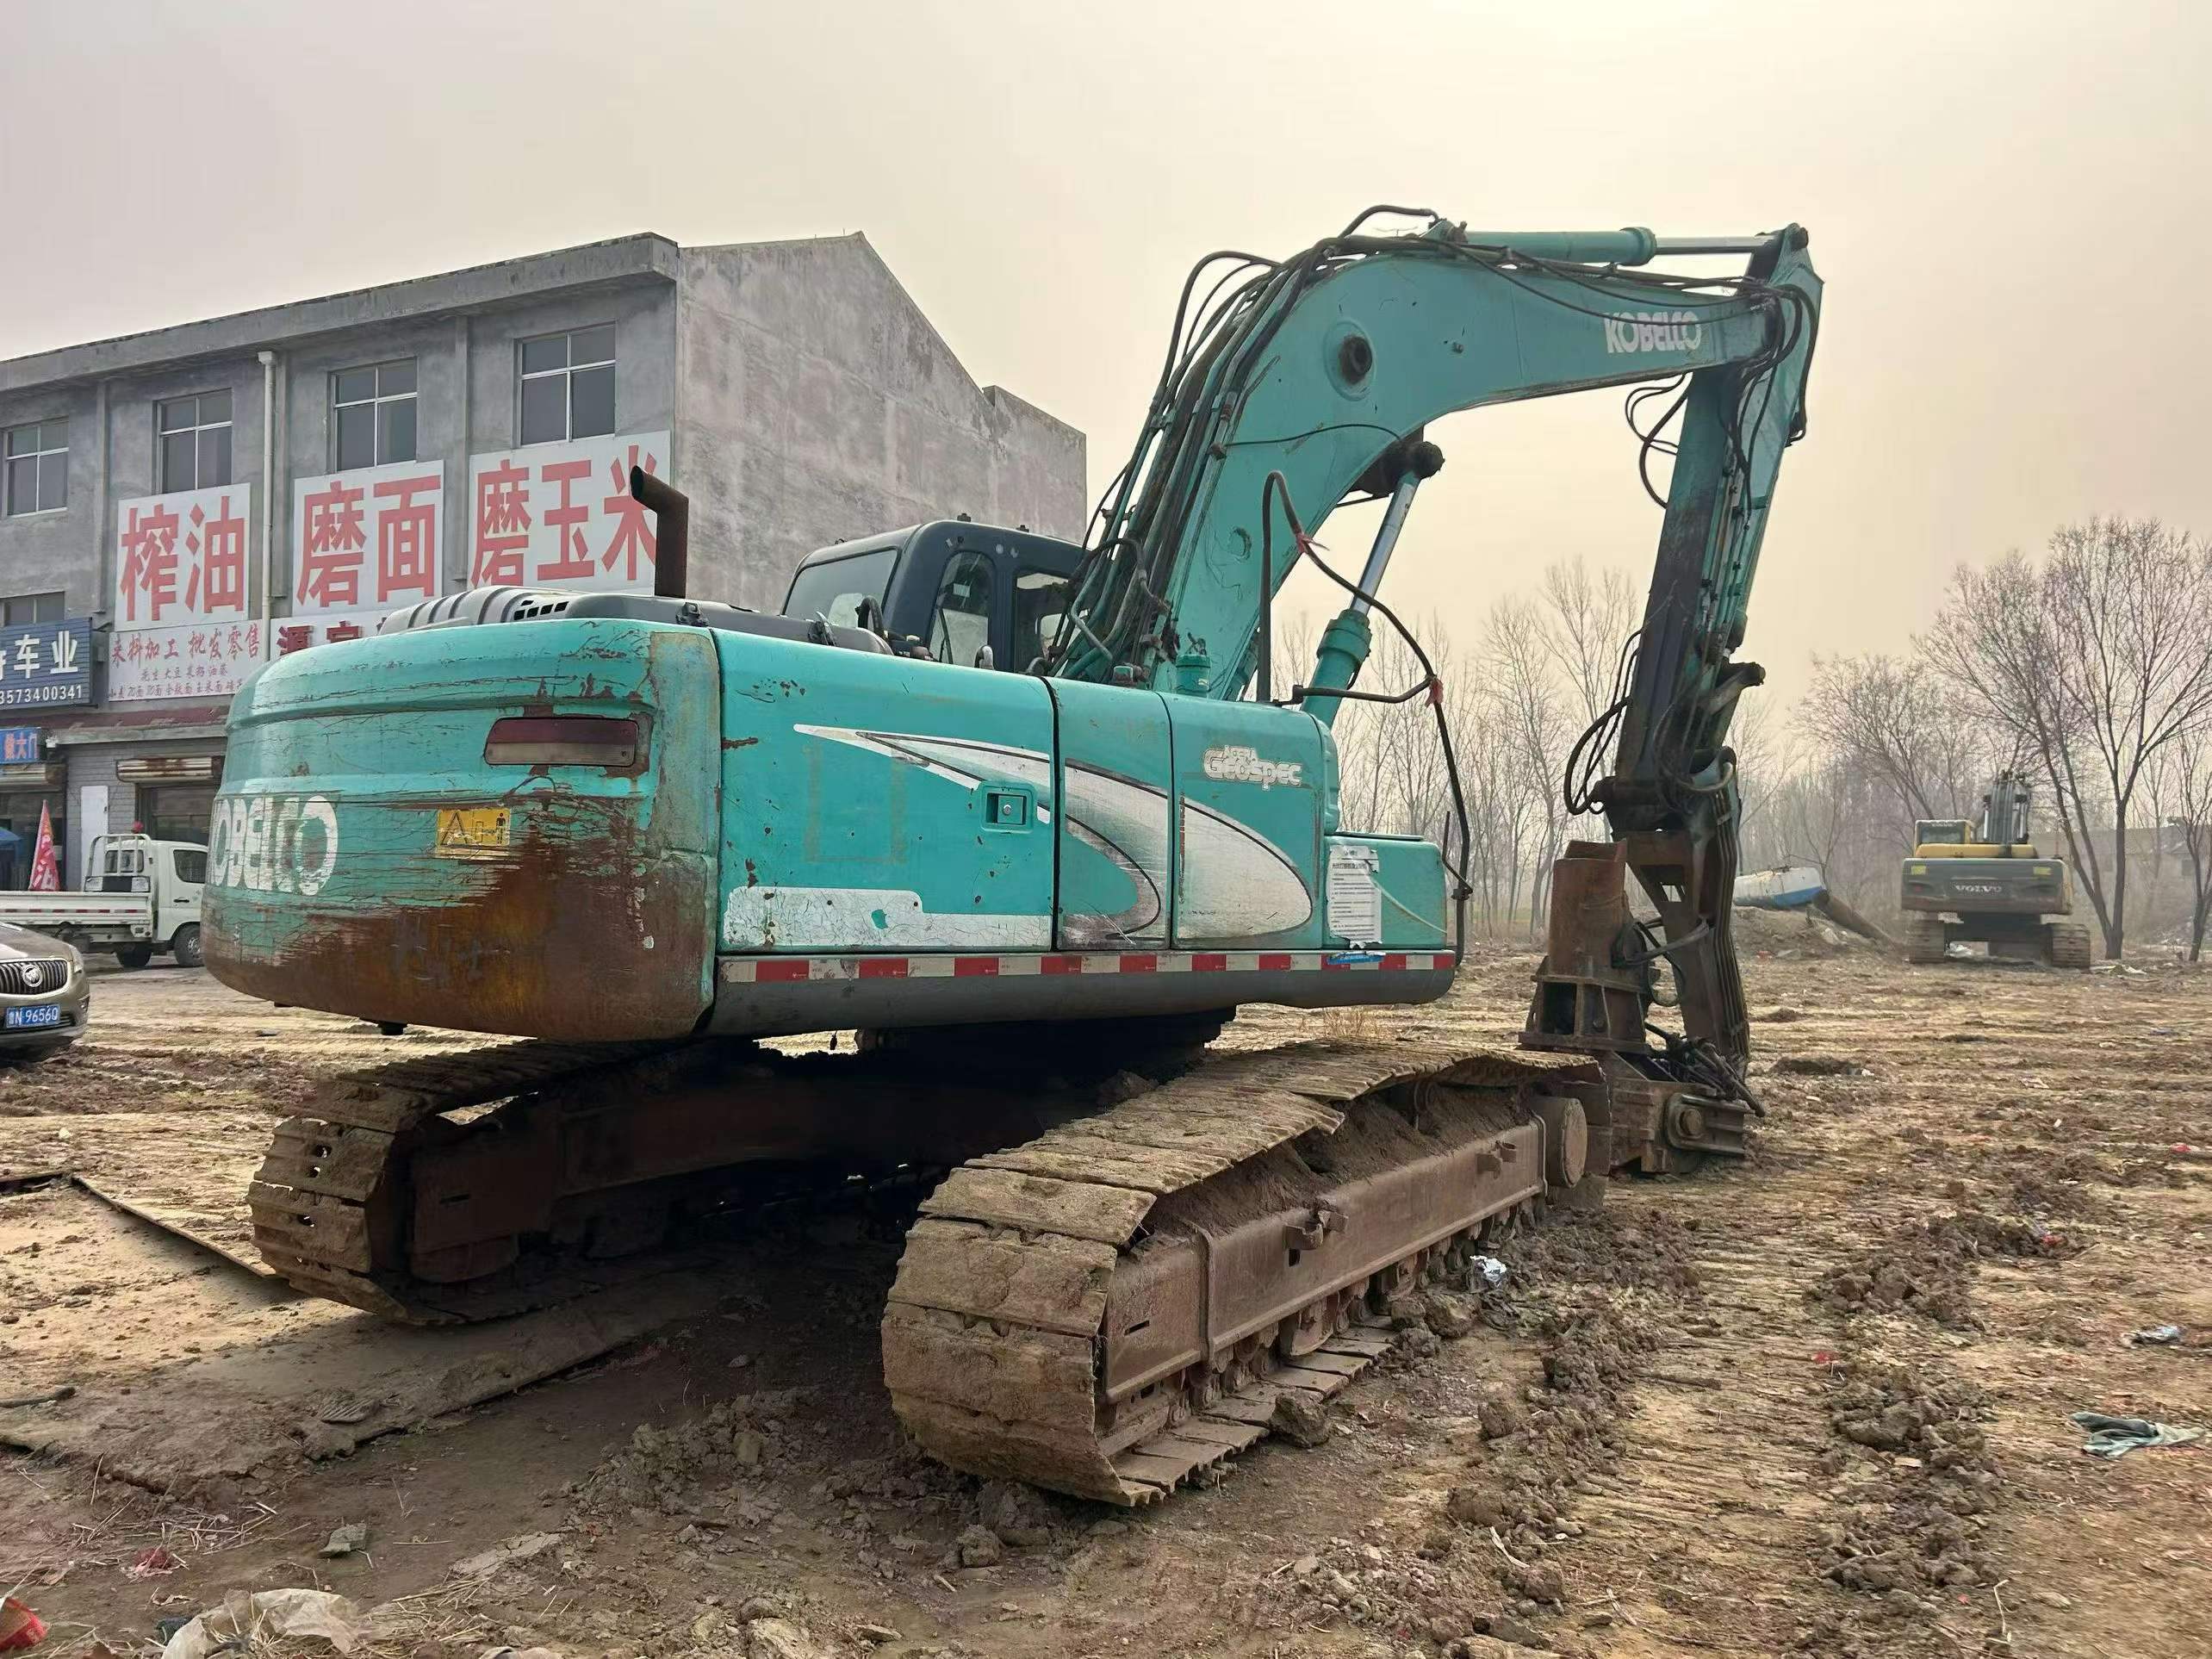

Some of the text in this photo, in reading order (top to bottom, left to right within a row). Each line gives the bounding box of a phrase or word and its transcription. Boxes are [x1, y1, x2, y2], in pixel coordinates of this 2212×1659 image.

[1604, 311, 1701, 353] KOBELCO
[120, 495, 245, 621] 榨油
[296, 475, 441, 607] 磨面
[470, 445, 657, 587] 磨玉米
[0, 631, 78, 680] 车业
[189, 623, 260, 661] 批发零售
[209, 795, 339, 896] OBELCO
